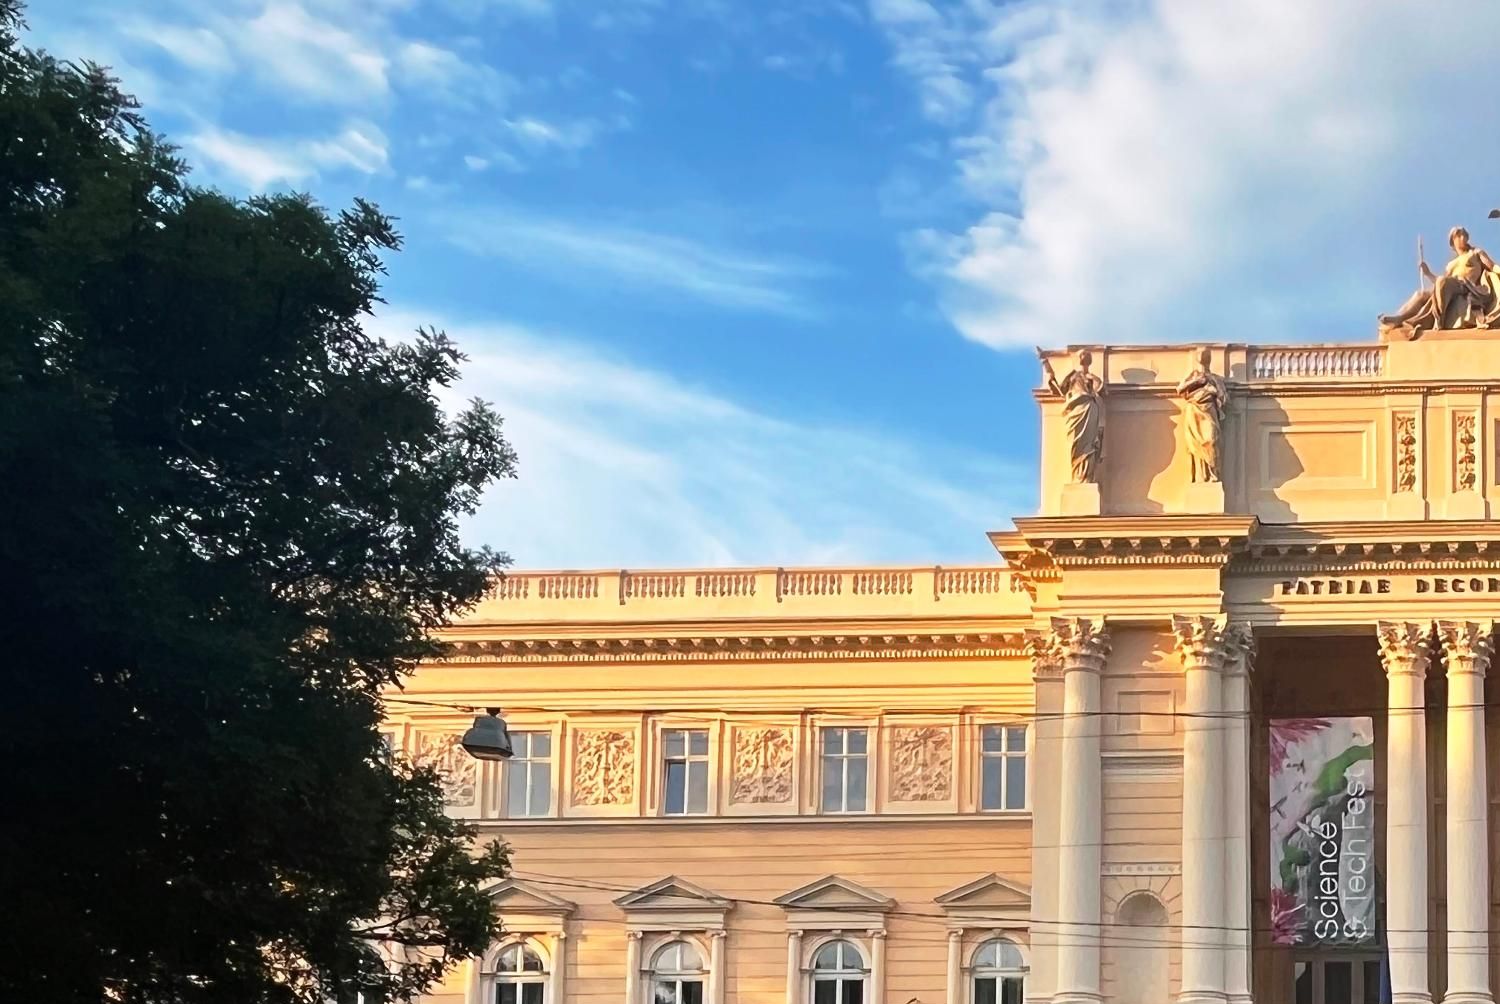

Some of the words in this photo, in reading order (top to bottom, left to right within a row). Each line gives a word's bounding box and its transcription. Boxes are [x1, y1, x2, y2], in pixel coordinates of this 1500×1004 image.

[1281, 579, 1391, 595] PATRIAE
[1314, 821, 1339, 939] Science
[1342, 839, 1367, 905] Tech
